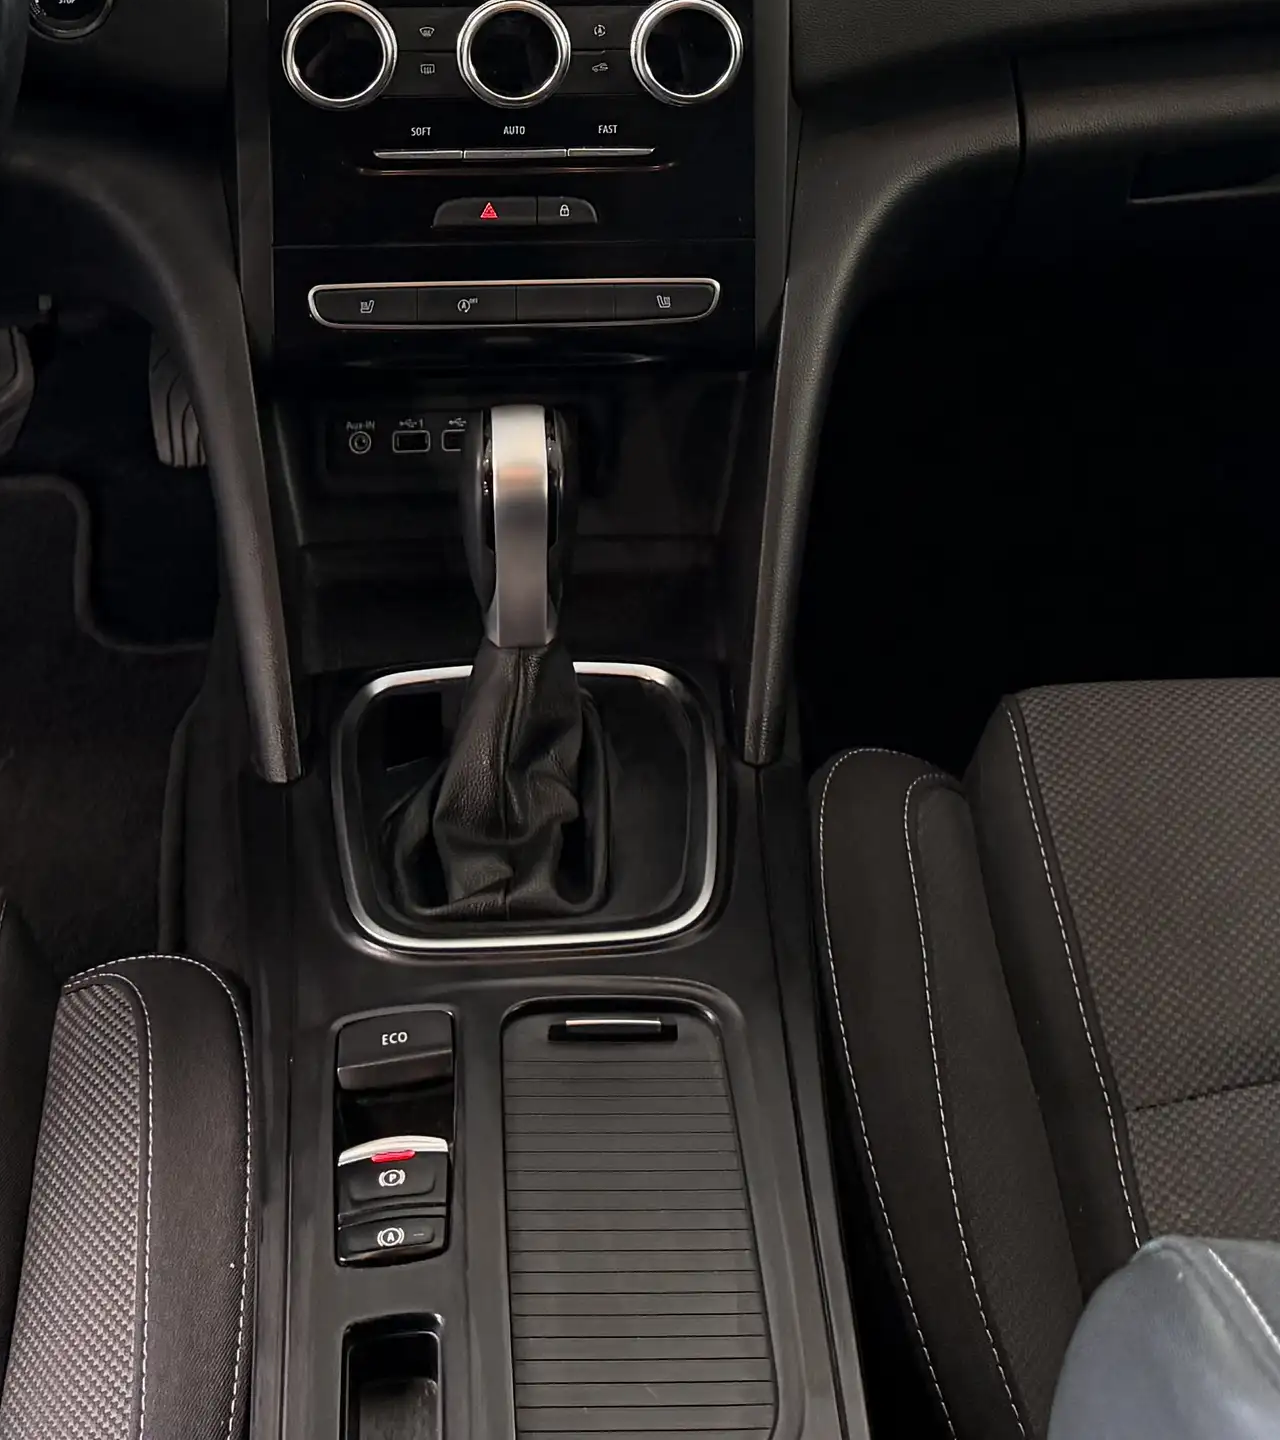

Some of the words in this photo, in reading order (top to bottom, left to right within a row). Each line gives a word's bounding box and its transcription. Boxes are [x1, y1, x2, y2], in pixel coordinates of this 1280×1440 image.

[411, 126, 432, 137] SOFT
[503, 125, 526, 136] AUTO
[598, 124, 618, 135] FAST
[381, 1031, 409, 1046] ECO
